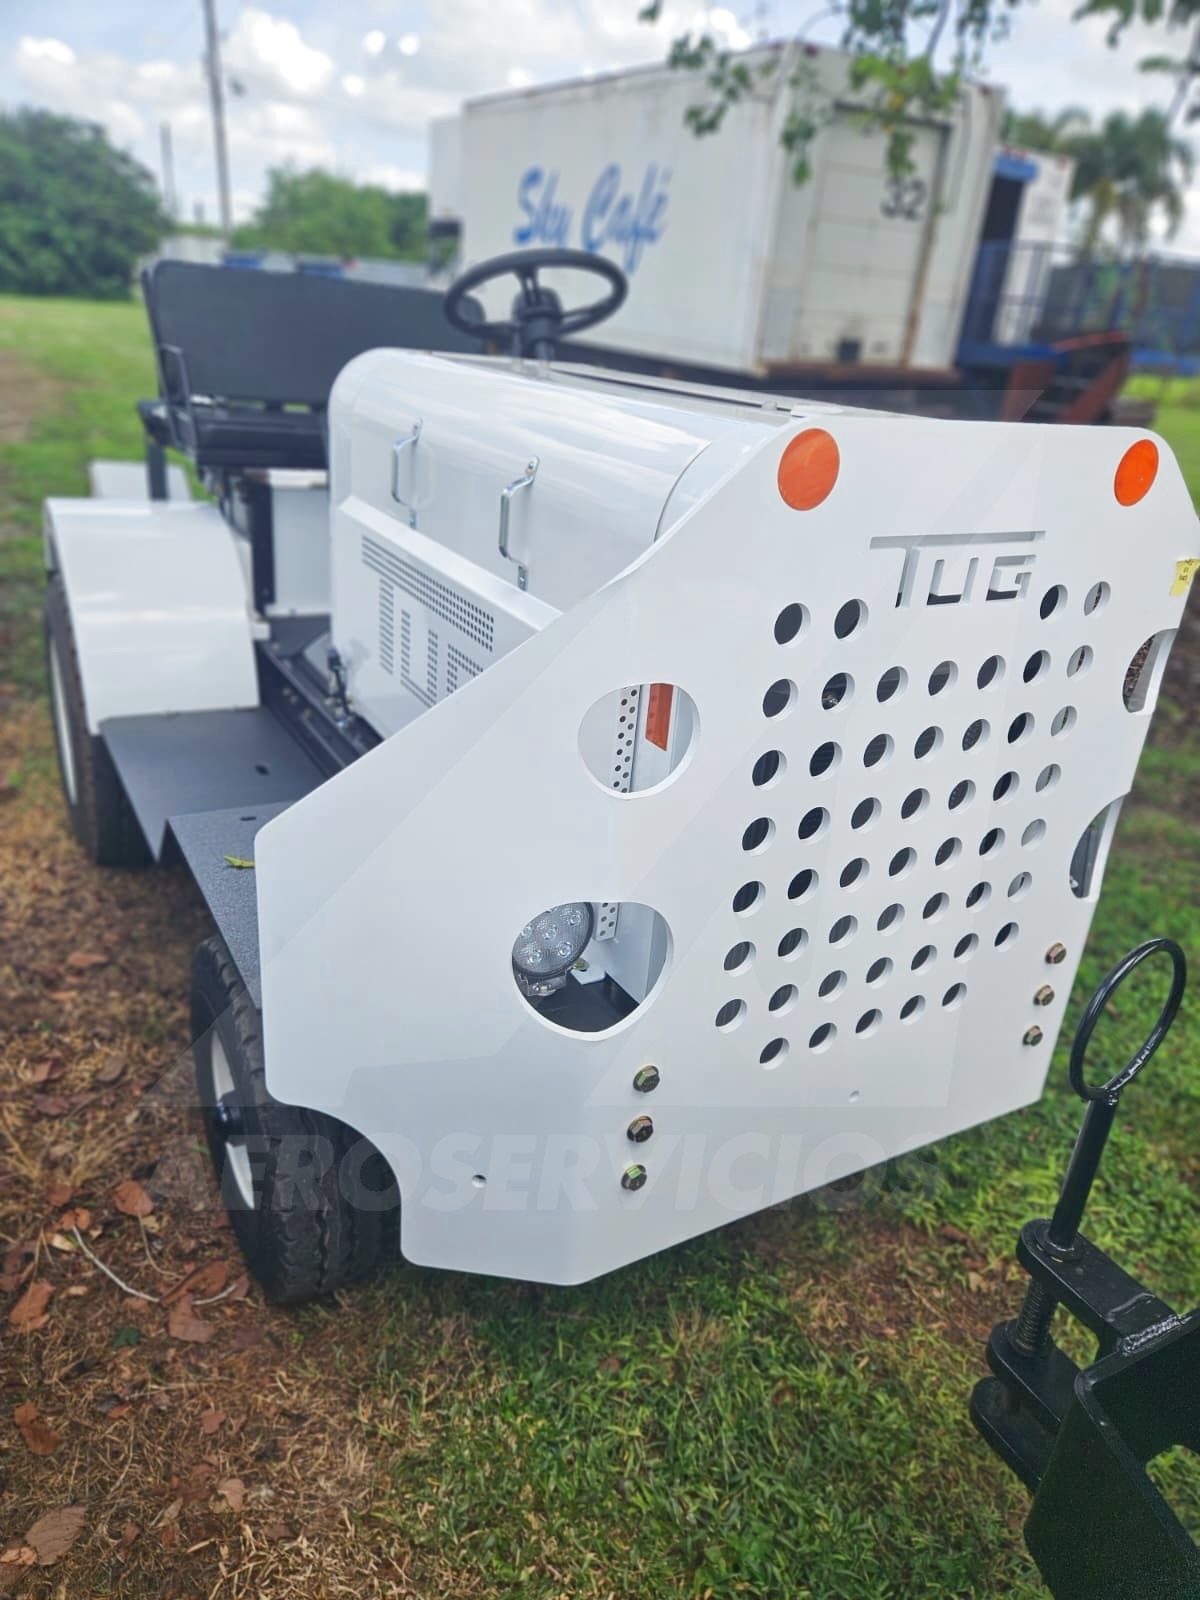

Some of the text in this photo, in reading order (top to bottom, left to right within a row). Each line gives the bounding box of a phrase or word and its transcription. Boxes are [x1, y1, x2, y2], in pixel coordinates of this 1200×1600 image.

[512, 161, 673, 275] Sky Café
[880, 177, 928, 221] 32
[869, 531, 1046, 609] TUG
